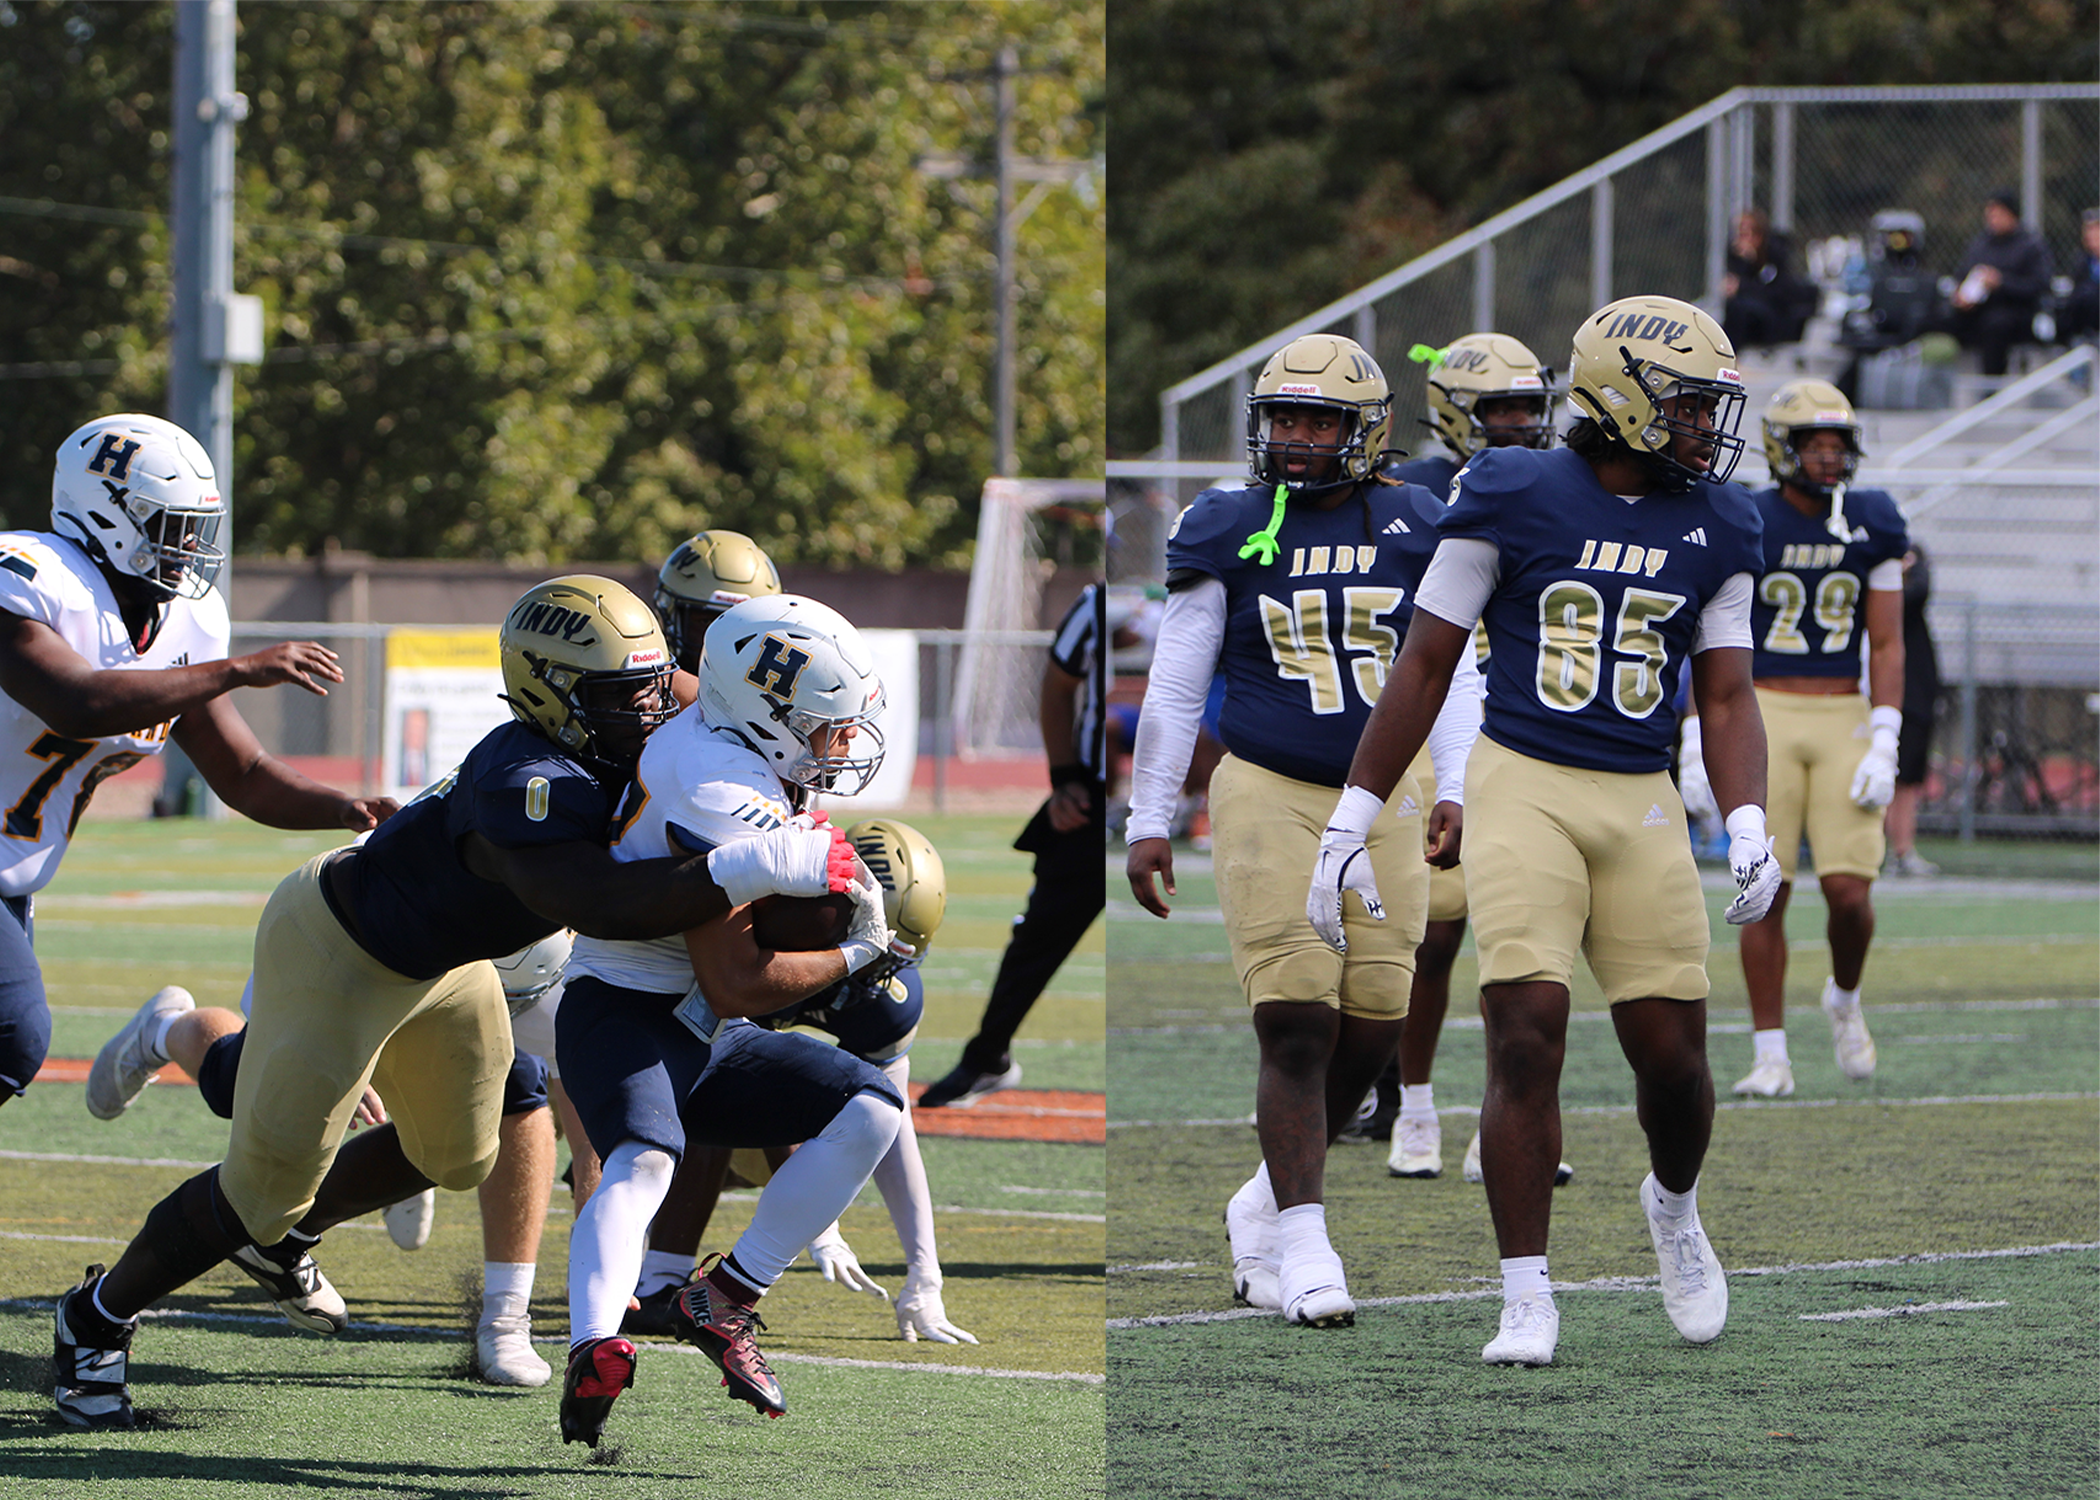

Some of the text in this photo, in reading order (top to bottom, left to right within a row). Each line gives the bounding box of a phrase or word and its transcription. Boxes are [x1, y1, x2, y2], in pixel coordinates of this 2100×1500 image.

[1604, 313, 1689, 346] INDY
[85, 431, 144, 485] H
[1289, 545, 1377, 577] INDY
[1574, 539, 1669, 578] INDY
[1780, 544, 1846, 569] INDY
[515, 601, 592, 641] INDY
[1759, 571, 1861, 654] 29
[632, 651, 661, 663] Riddell
[744, 632, 814, 702] H
[1258, 586, 1405, 715] 45
[1536, 580, 1687, 720] 85
[525, 776, 551, 822] 0
[1642, 817, 1670, 827] adidas
[690, 1288, 713, 1327] NIKE
